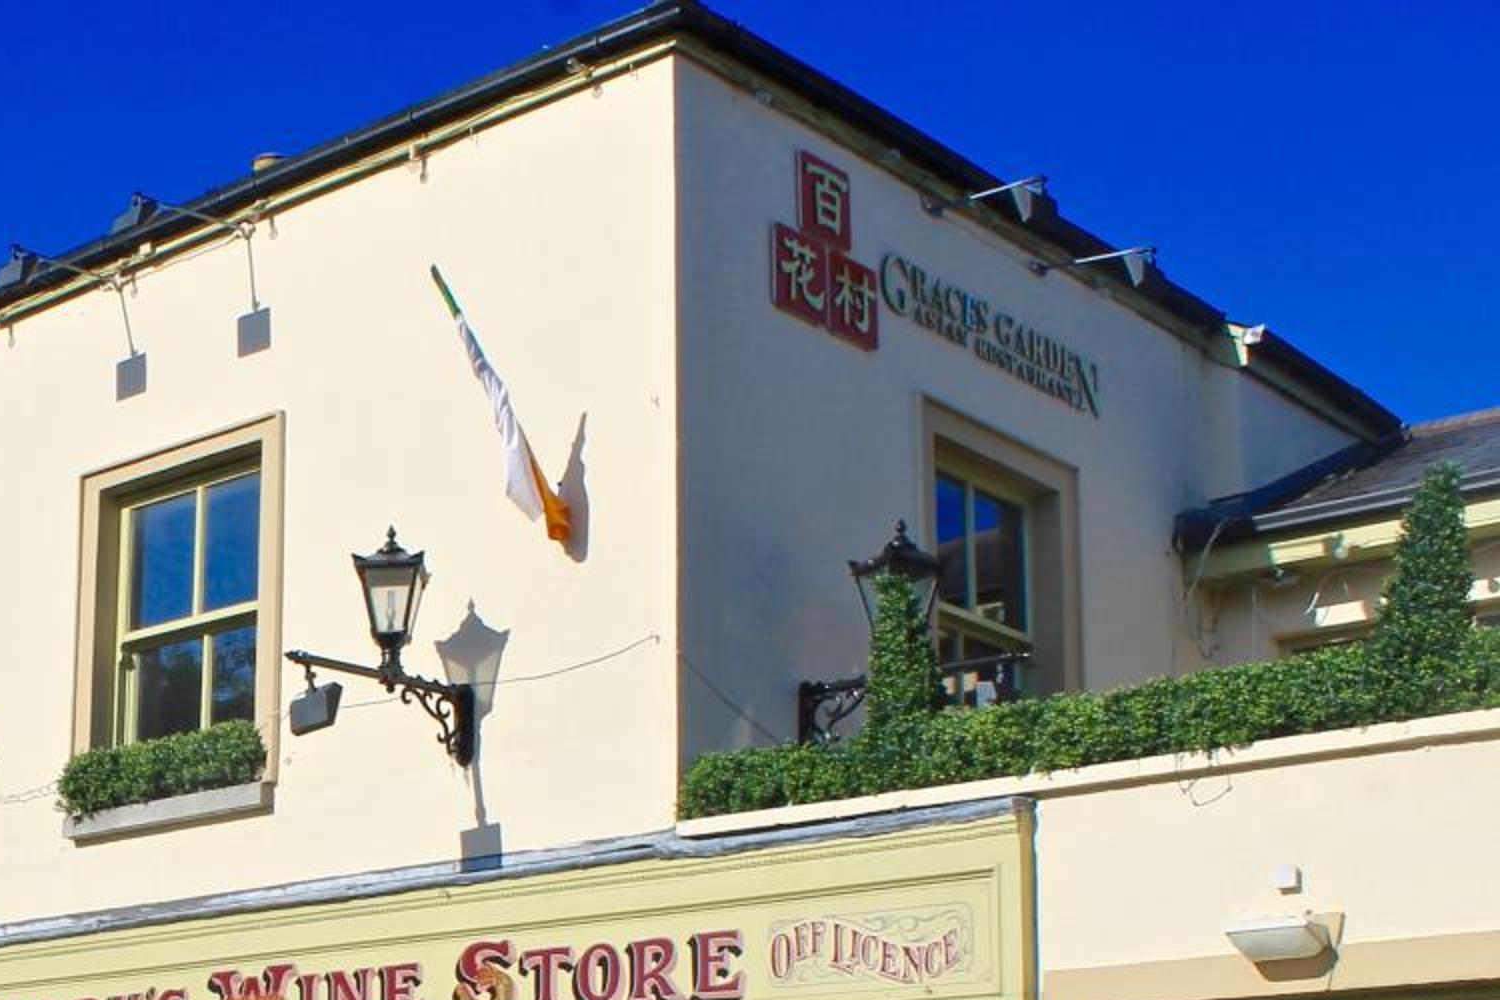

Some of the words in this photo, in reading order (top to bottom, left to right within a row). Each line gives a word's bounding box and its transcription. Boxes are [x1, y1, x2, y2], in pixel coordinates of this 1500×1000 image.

[805, 163, 848, 235] 百
[782, 238, 874, 333] 花村
[770, 920, 826, 979] OFF
[830, 922, 963, 985] LICENCE
